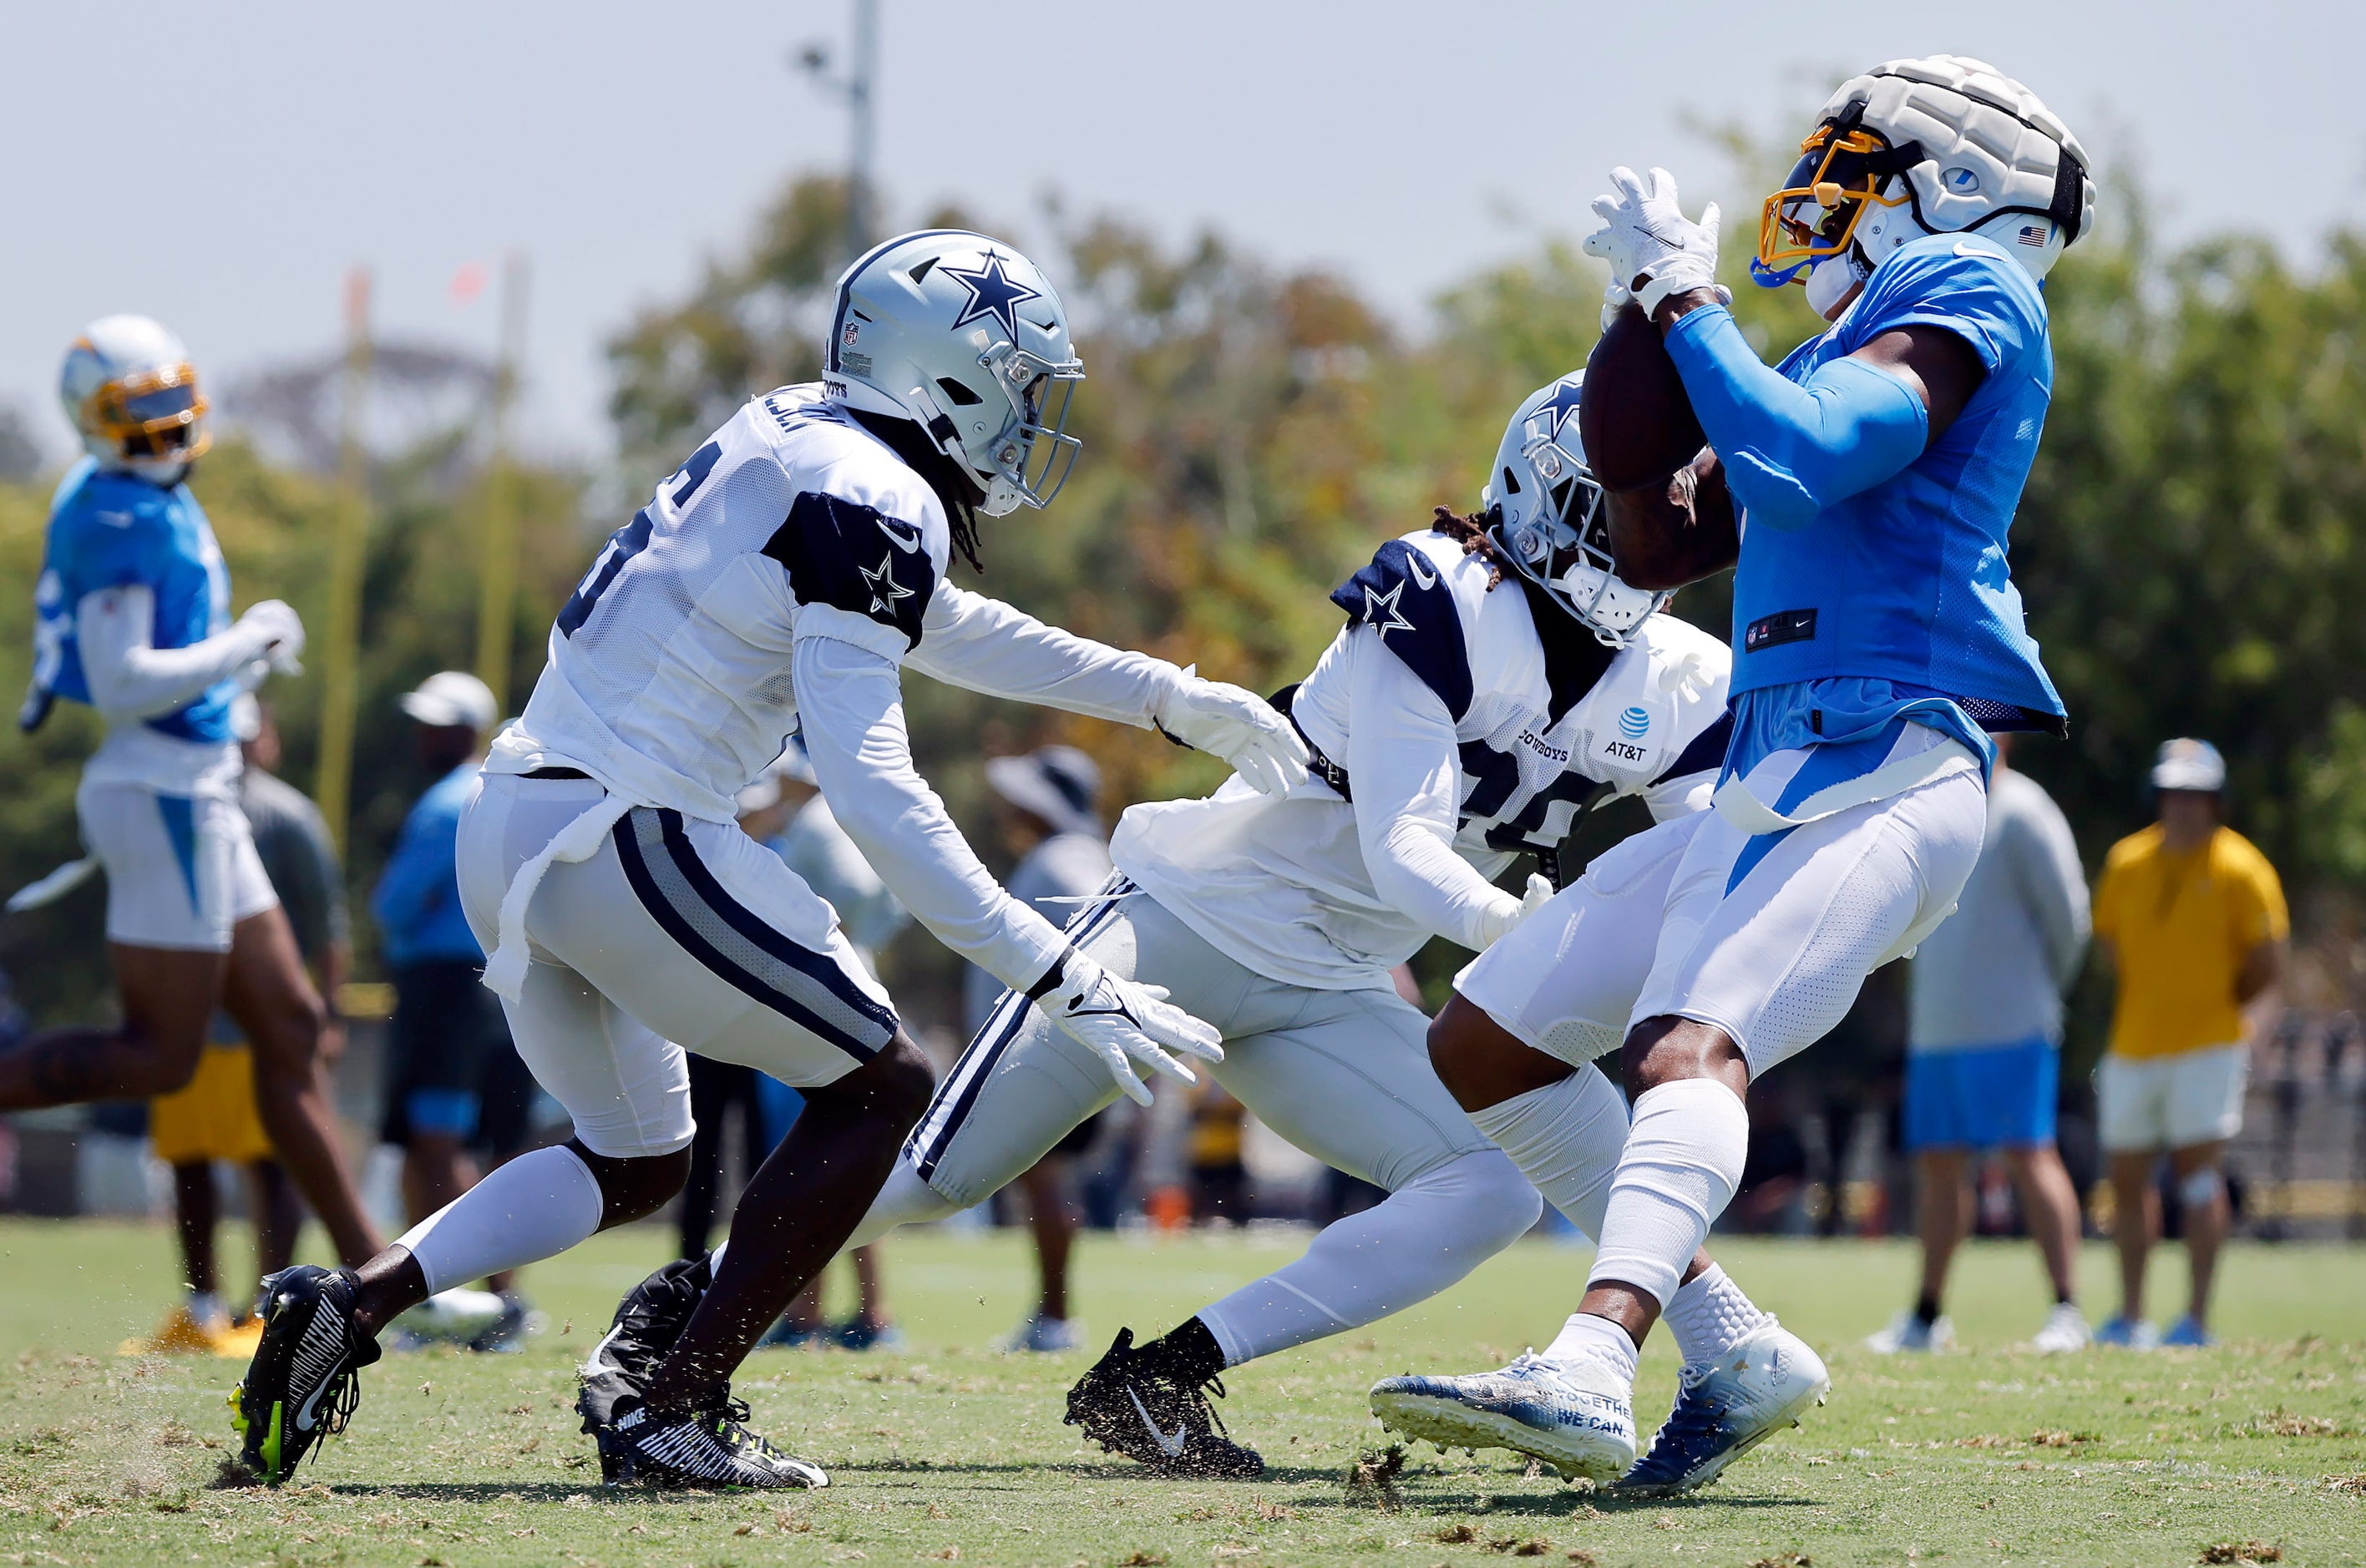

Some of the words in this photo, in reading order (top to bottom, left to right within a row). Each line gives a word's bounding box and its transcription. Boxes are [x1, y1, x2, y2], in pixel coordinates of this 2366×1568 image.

[844, 331, 857, 343] NFL
[1604, 741, 1647, 761] AT&T
[1556, 1389, 1631, 1420] TOGETHE
[617, 1407, 646, 1432] NIKE
[1558, 1409, 1583, 1427] WE
